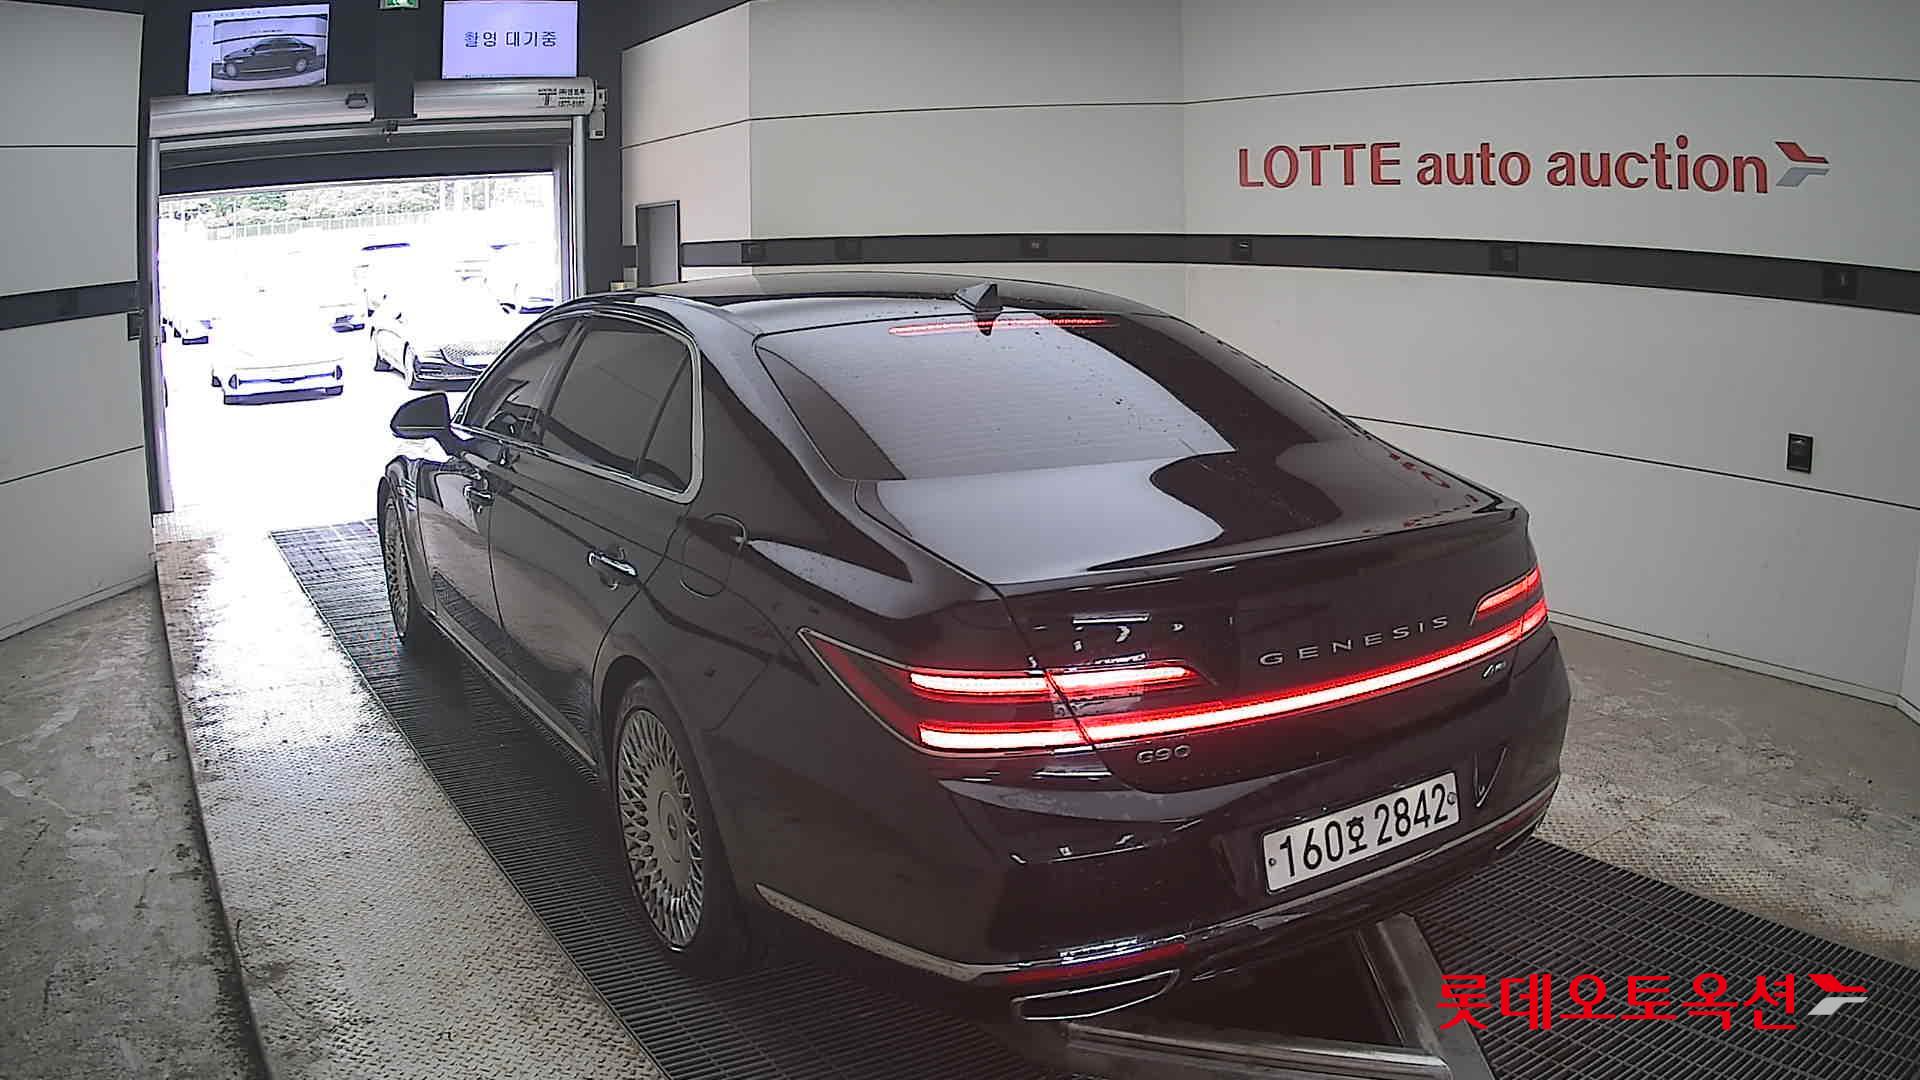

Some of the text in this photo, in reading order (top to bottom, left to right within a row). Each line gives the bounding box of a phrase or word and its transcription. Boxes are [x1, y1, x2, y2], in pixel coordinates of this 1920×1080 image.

[505, 30, 557, 48] 대기중
[1238, 135, 1768, 193] LOTTE auto auction
[1259, 616, 1449, 666] GENESIS
[1136, 745, 1191, 764] G90
[1374, 783, 1449, 846] 2842
